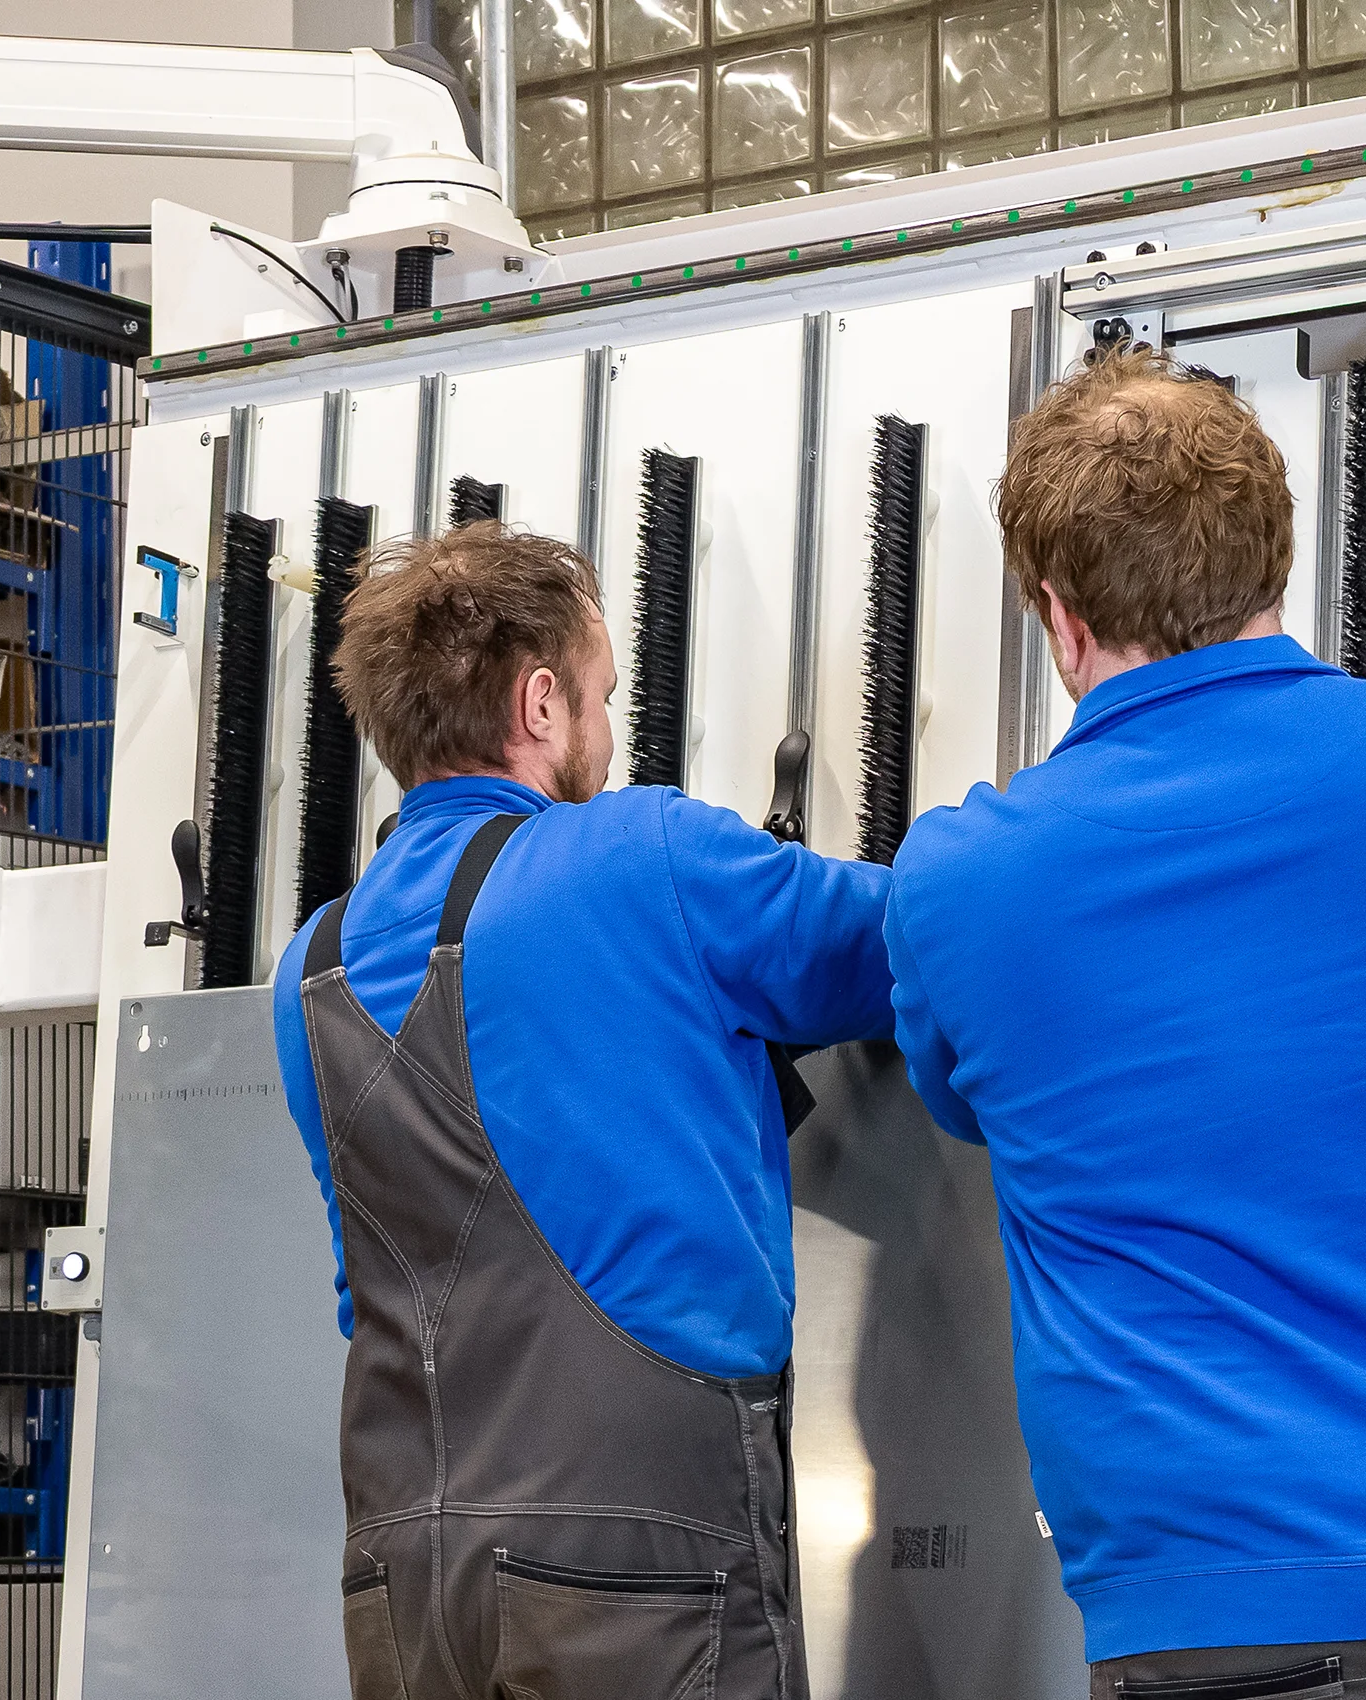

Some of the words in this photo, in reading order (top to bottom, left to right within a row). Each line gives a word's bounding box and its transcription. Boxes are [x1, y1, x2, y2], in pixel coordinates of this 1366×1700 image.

[838, 318, 846, 332] 5
[619, 353, 627, 364] 4
[449, 383, 457, 397] 3
[351, 401, 358, 412] 2
[257, 416, 264, 430] 1
